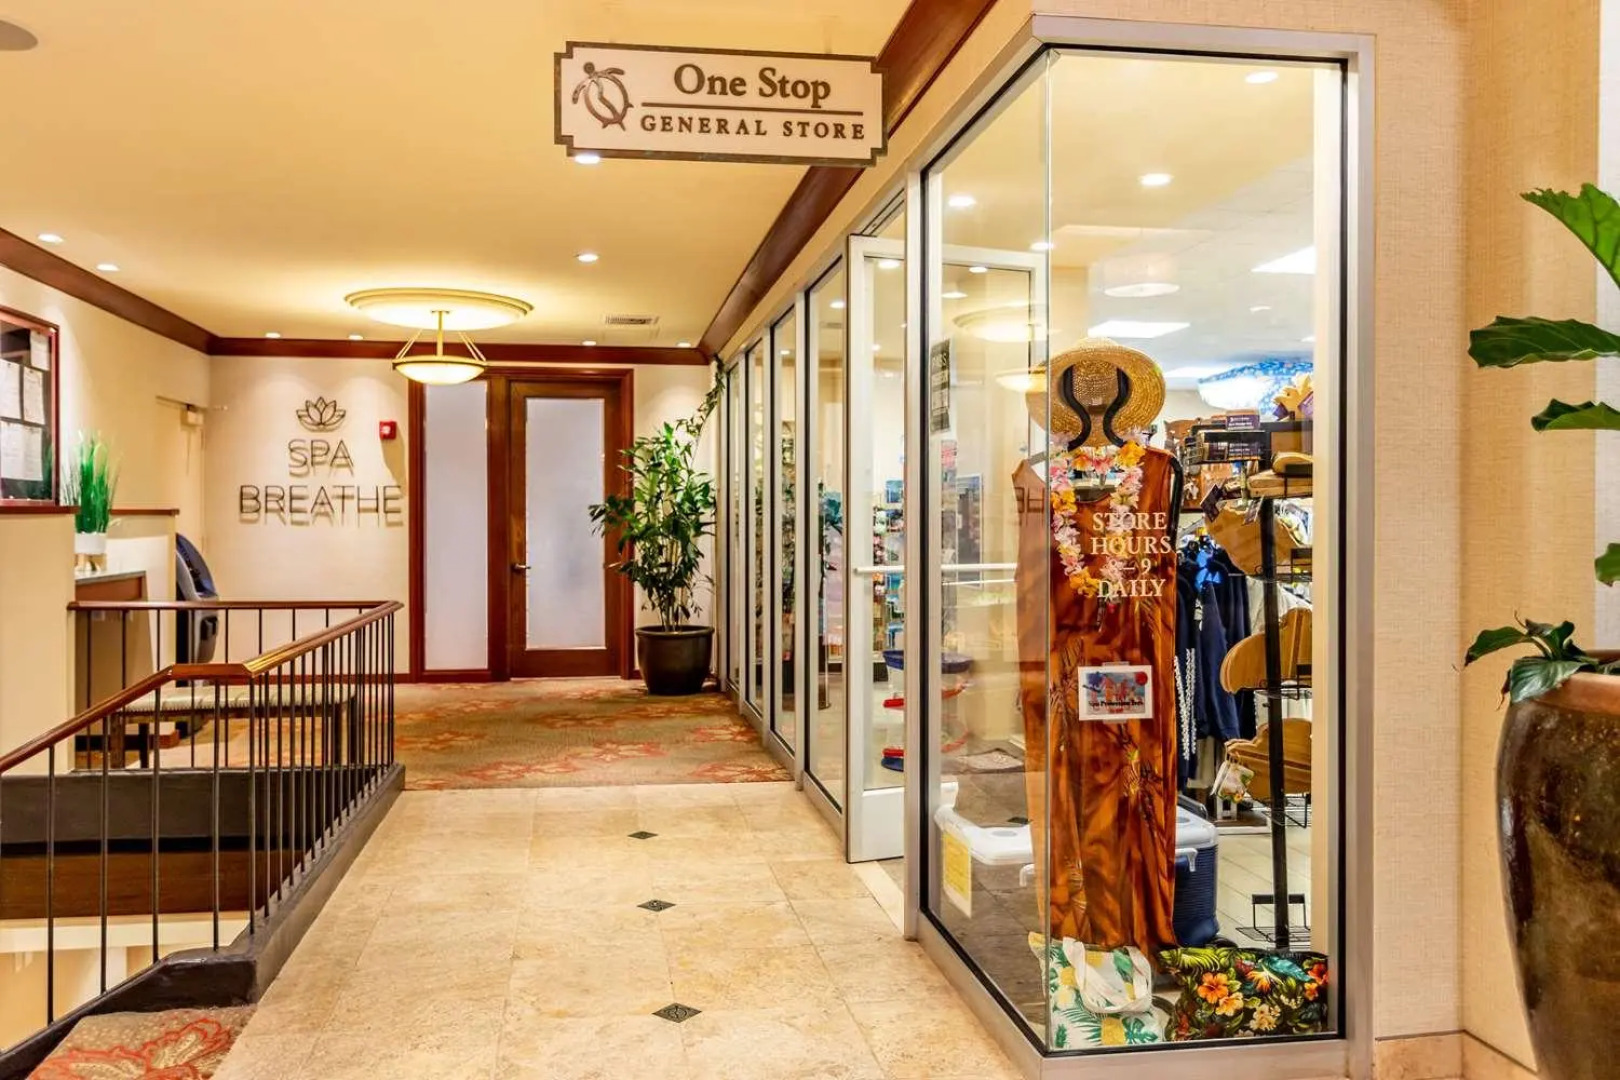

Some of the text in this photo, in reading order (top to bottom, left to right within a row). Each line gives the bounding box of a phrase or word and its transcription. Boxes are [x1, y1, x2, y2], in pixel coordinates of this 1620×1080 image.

[674, 63, 831, 108] One Stop
[640, 115, 865, 140] GENERAL STORE
[288, 439, 354, 467] SPA
[240, 485, 402, 514] BREATHE
[1092, 512, 1167, 530] STORE
[1090, 536, 1172, 555] HOURS
[1097, 578, 1167, 598] DAILY
